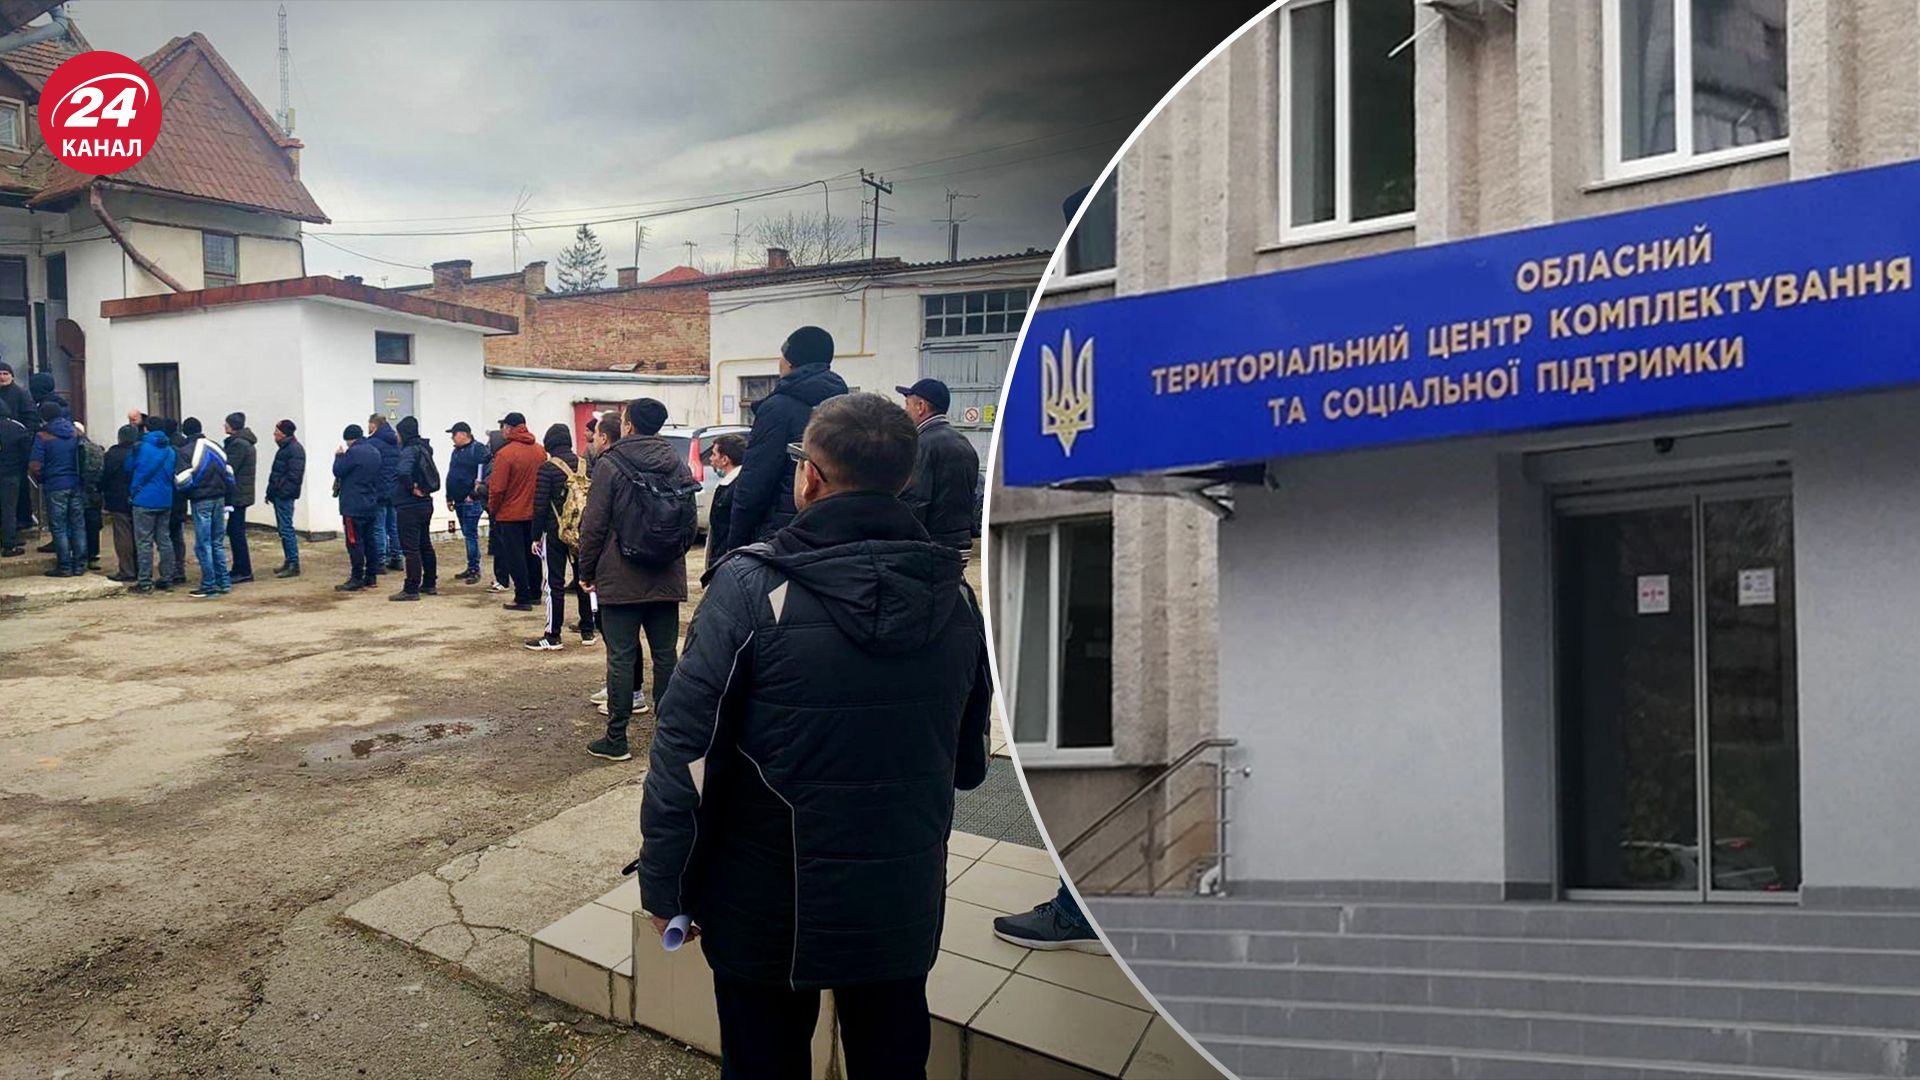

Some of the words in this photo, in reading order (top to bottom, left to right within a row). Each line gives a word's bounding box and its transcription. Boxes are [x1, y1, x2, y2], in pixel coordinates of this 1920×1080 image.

[1516, 223, 1713, 293] ОБЛАСНИЙ
[1151, 324, 1410, 396] ТЕРИТОРІАЛЬНИЙ
[1427, 313, 1533, 360] ЦЕНТР
[1550, 256, 1912, 339] КОМПЛЕКТУВАННЯ
[1268, 396, 1306, 426] ТА
[1324, 357, 1520, 420] СОЦІАЛЬНОЇ
[1537, 336, 1744, 394] ПІДТРИМКИ
